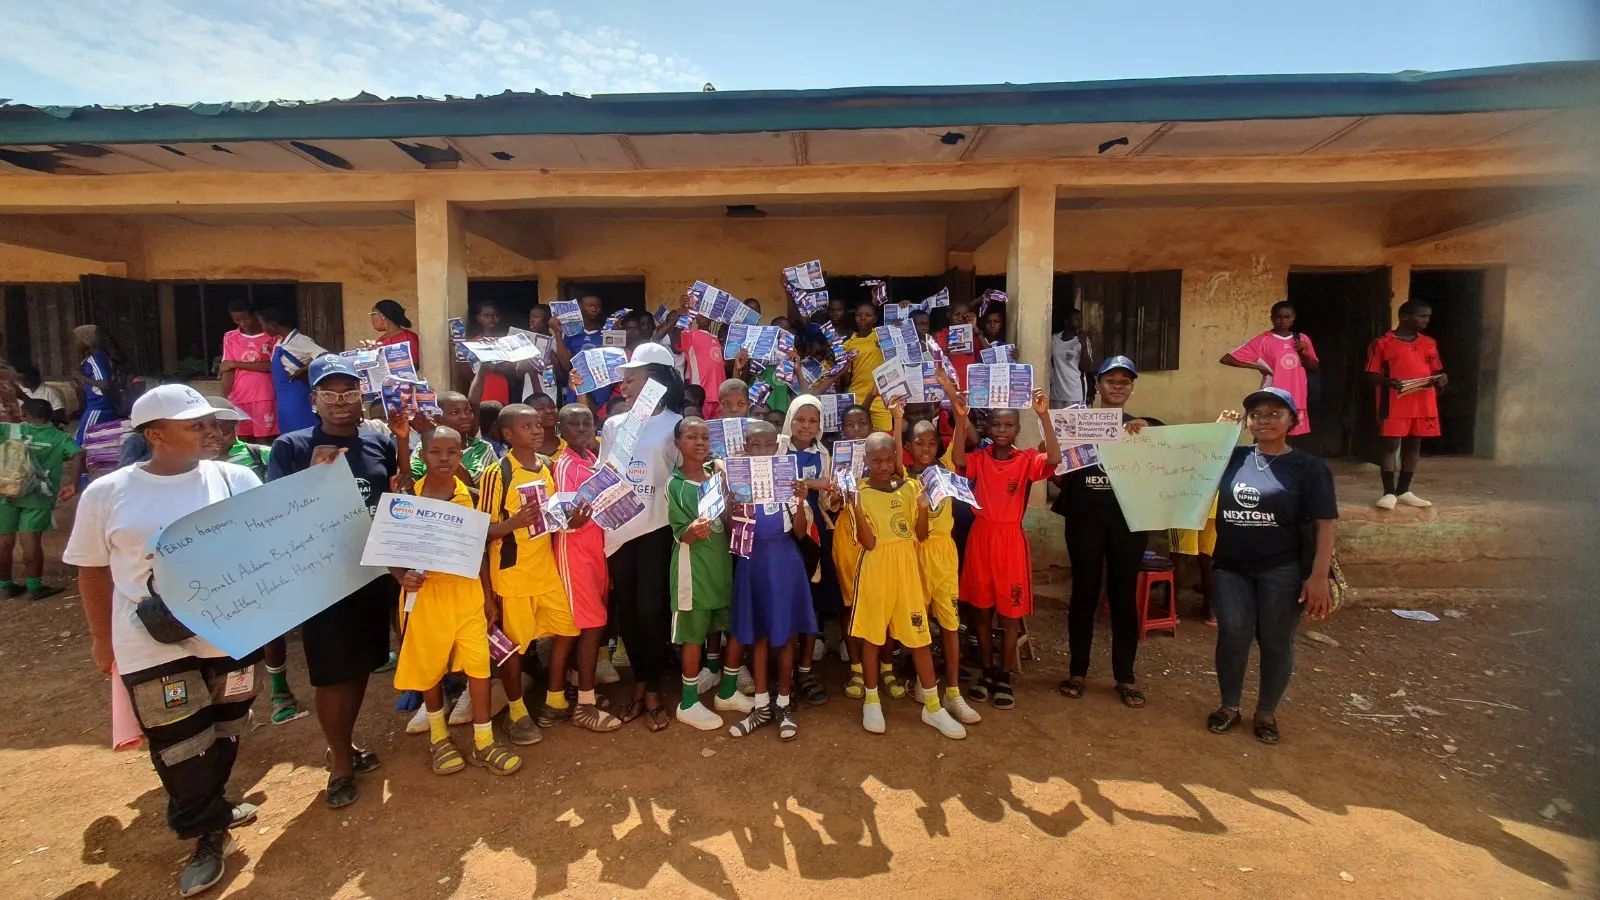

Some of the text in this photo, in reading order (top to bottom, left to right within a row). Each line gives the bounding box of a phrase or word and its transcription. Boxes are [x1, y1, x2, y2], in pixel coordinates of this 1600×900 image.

[1077, 412, 1118, 421] NEXTGEN
[1123, 436, 1151, 444] GIENE
[628, 466, 648, 475] NPHAI
[1085, 476, 1109, 484] NEXT
[633, 484, 656, 494] TGEN
[1238, 494, 1259, 502] NPHAI
[393, 507, 414, 515] NPHAI
[416, 509, 464, 525] NEXTGEN
[1223, 510, 1275, 522] NEXTGEN
[187, 571, 236, 602] Small
